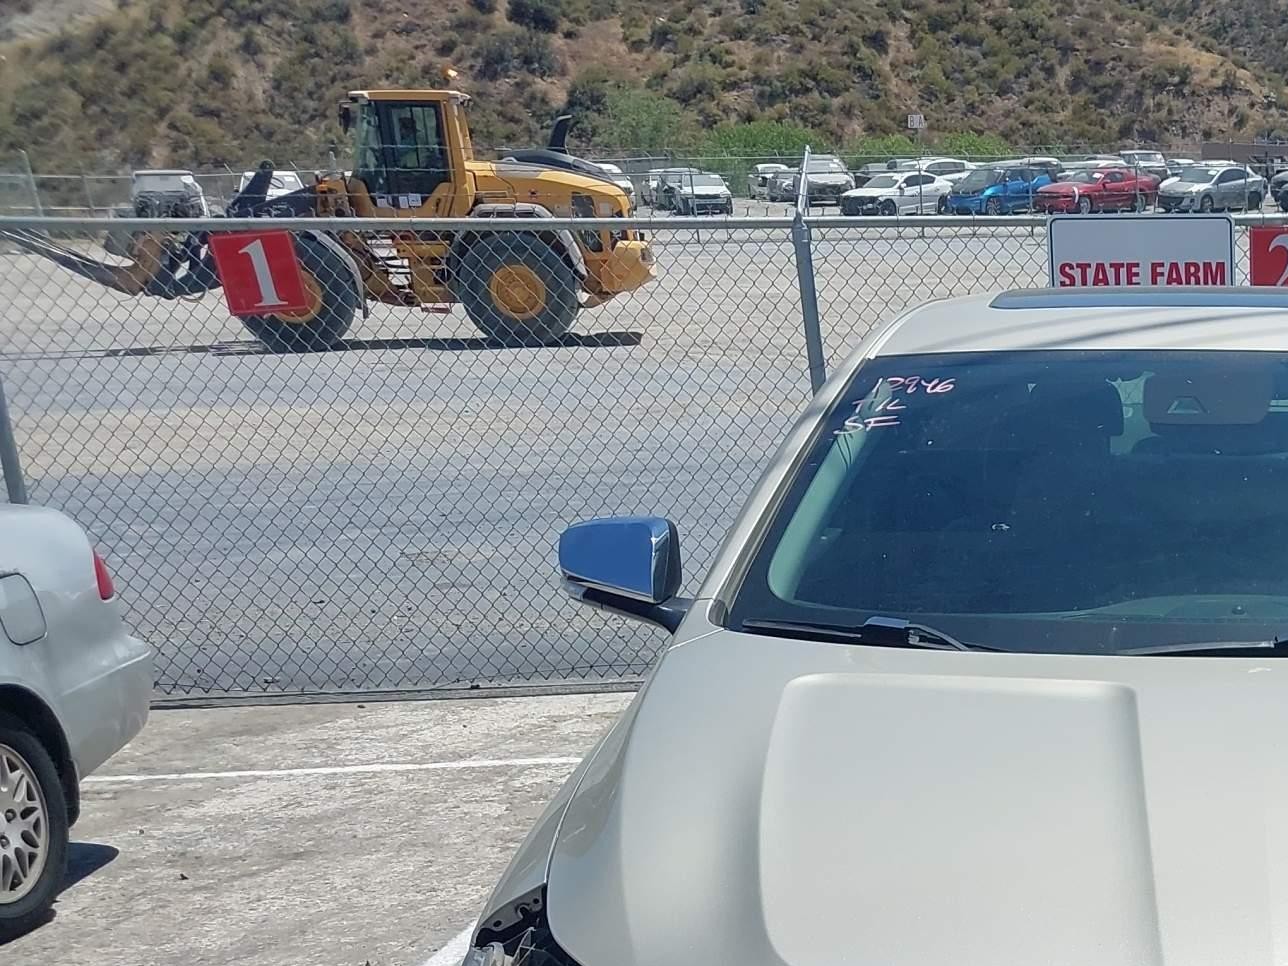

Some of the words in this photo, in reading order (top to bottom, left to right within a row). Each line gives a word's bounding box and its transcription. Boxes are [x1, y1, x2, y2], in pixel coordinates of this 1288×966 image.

[238, 239, 288, 306] 1
[1059, 262, 1141, 286] STATE
[1151, 261, 1226, 286] FARM
